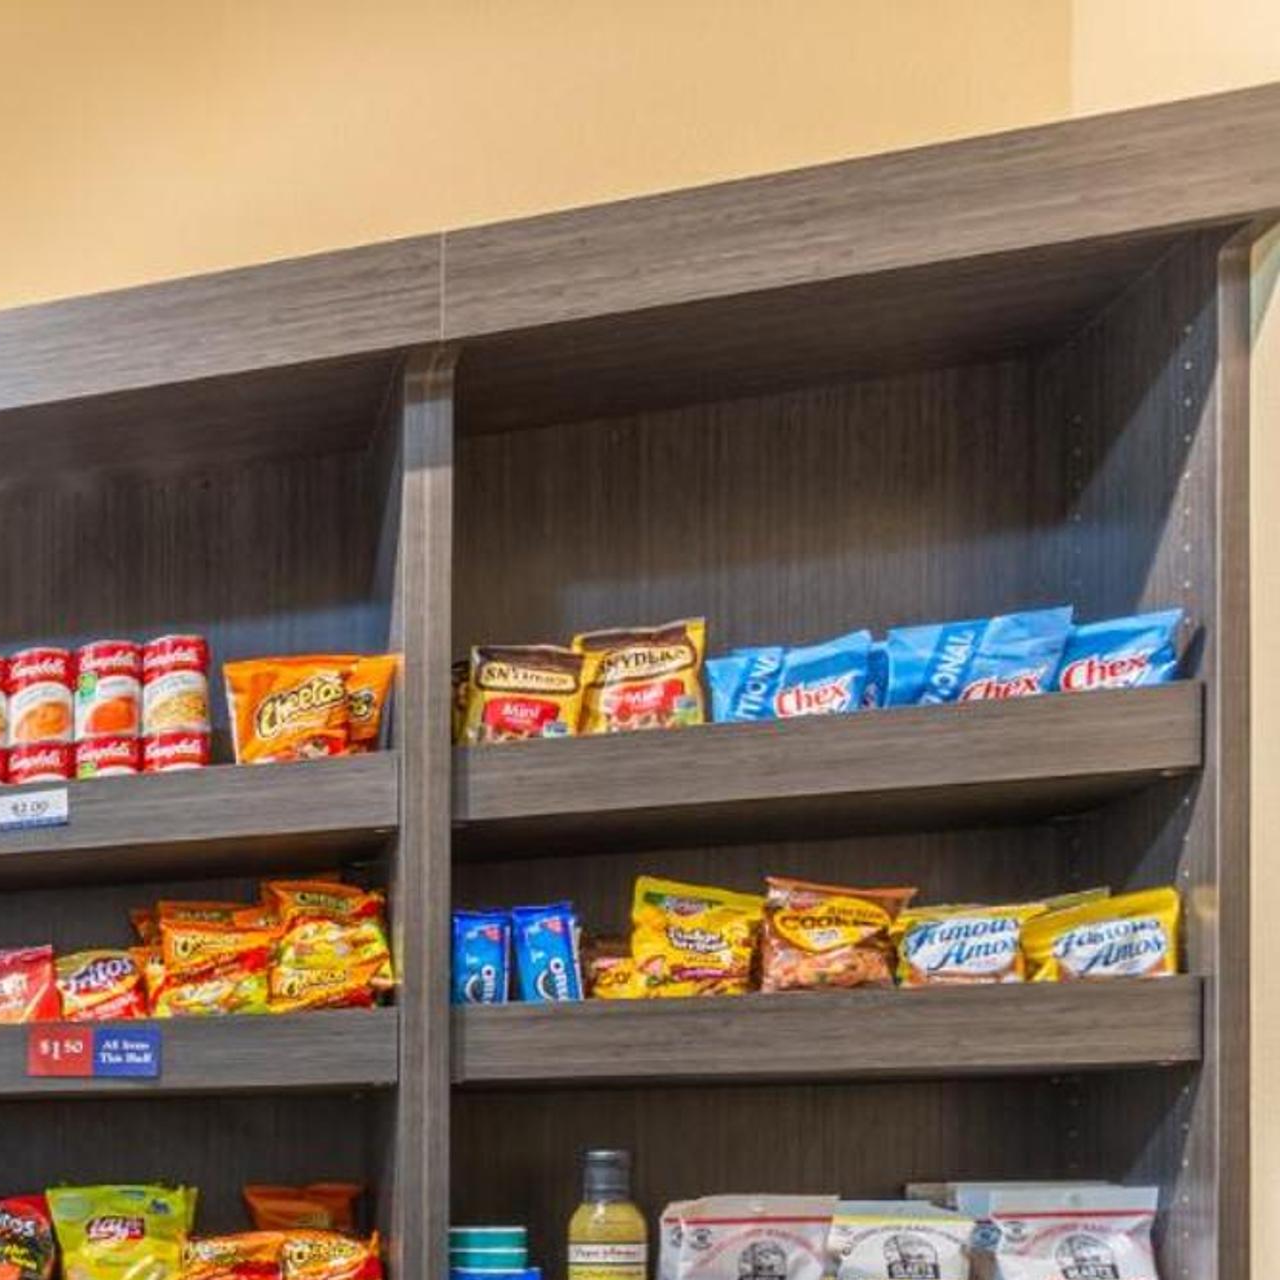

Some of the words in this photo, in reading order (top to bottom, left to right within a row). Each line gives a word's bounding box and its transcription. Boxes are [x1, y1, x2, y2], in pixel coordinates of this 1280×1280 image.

[1060, 652, 1148, 692] Chex
[255, 670, 345, 740] Cheetos
[775, 676, 851, 719] Chex
[904, 916, 1020, 955] Famous
[938, 938, 1018, 970] Amos
[1086, 936, 1162, 974] Amos
[69, 956, 134, 994] Fritos
[481, 964, 497, 1002] ORE
[549, 956, 571, 1001] ORE
